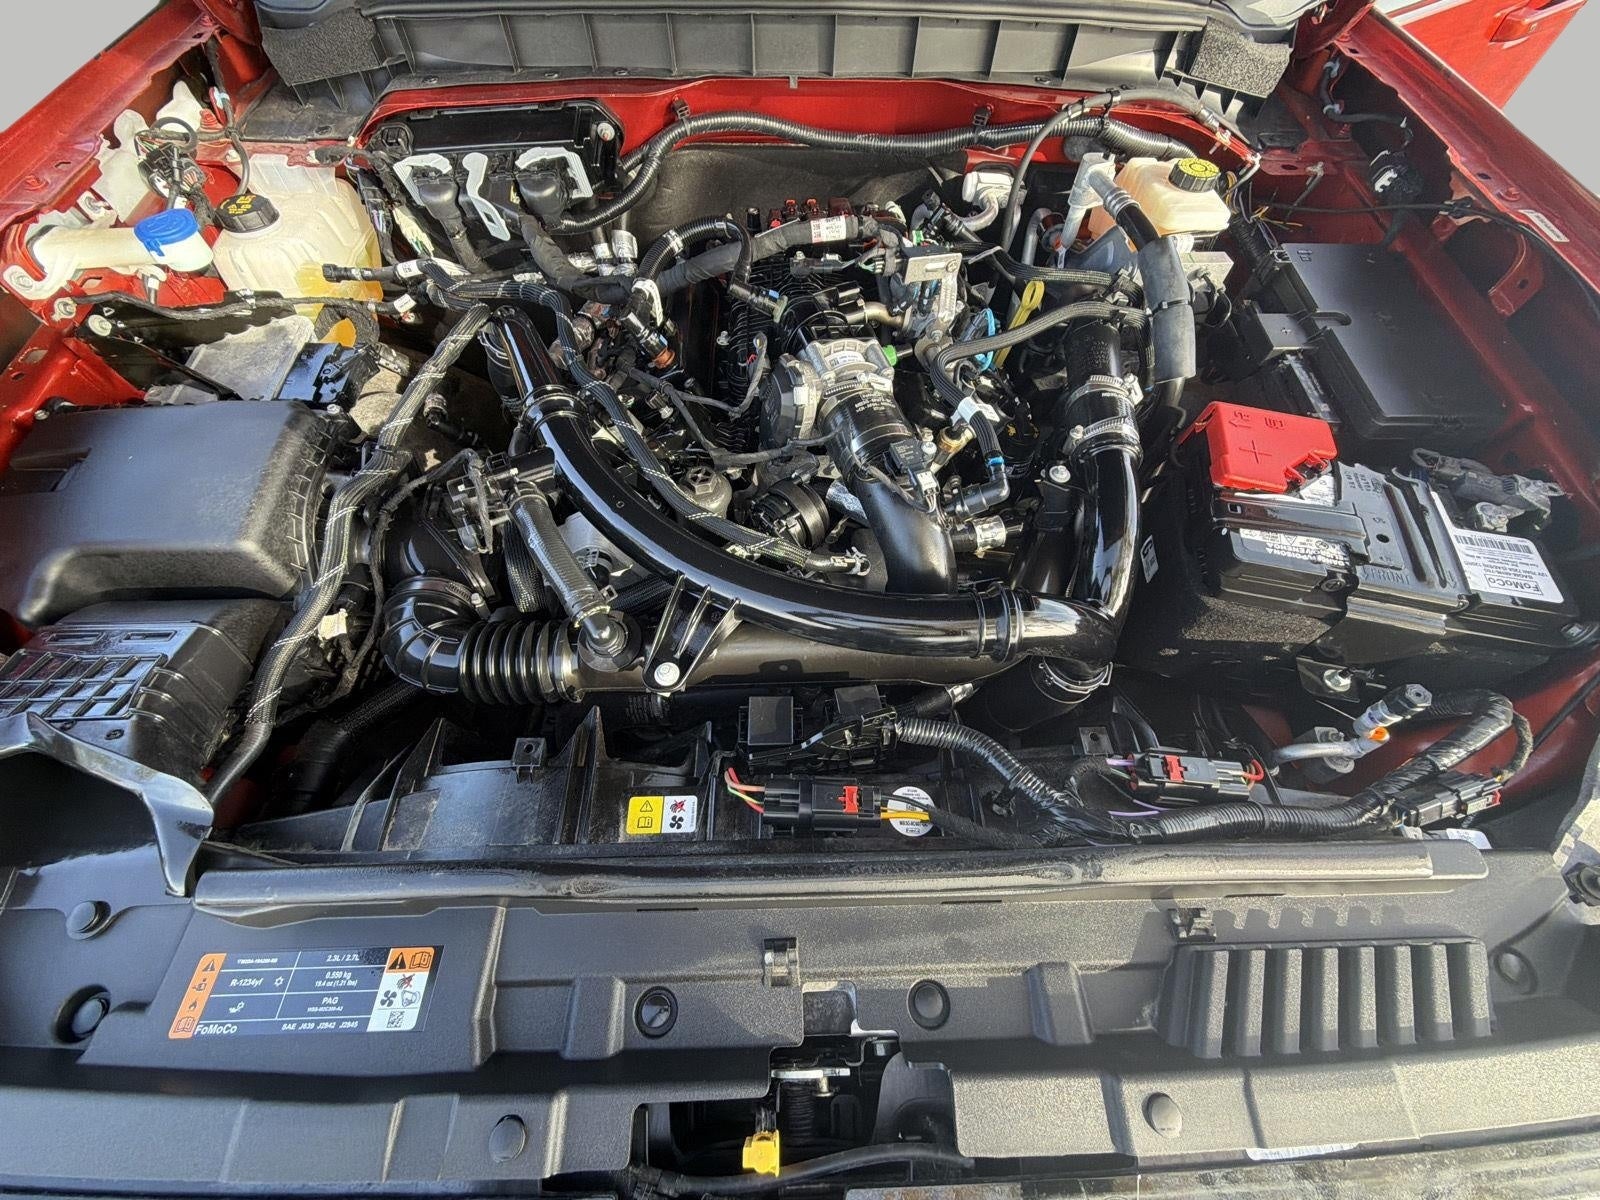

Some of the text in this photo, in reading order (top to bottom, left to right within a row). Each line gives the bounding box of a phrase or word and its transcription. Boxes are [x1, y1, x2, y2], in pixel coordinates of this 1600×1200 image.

[1488, 577, 1540, 592] FoMoCo
[326, 954, 341, 962] 2.3L
[345, 953, 359, 962] 2.7L
[325, 971, 343, 980] 0.550
[229, 977, 264, 988] R-1234yf
[322, 997, 338, 1005] PAG
[194, 1023, 237, 1035] FoMoCo
[281, 1022, 296, 1031] SAE
[298, 1022, 314, 1031] J639
